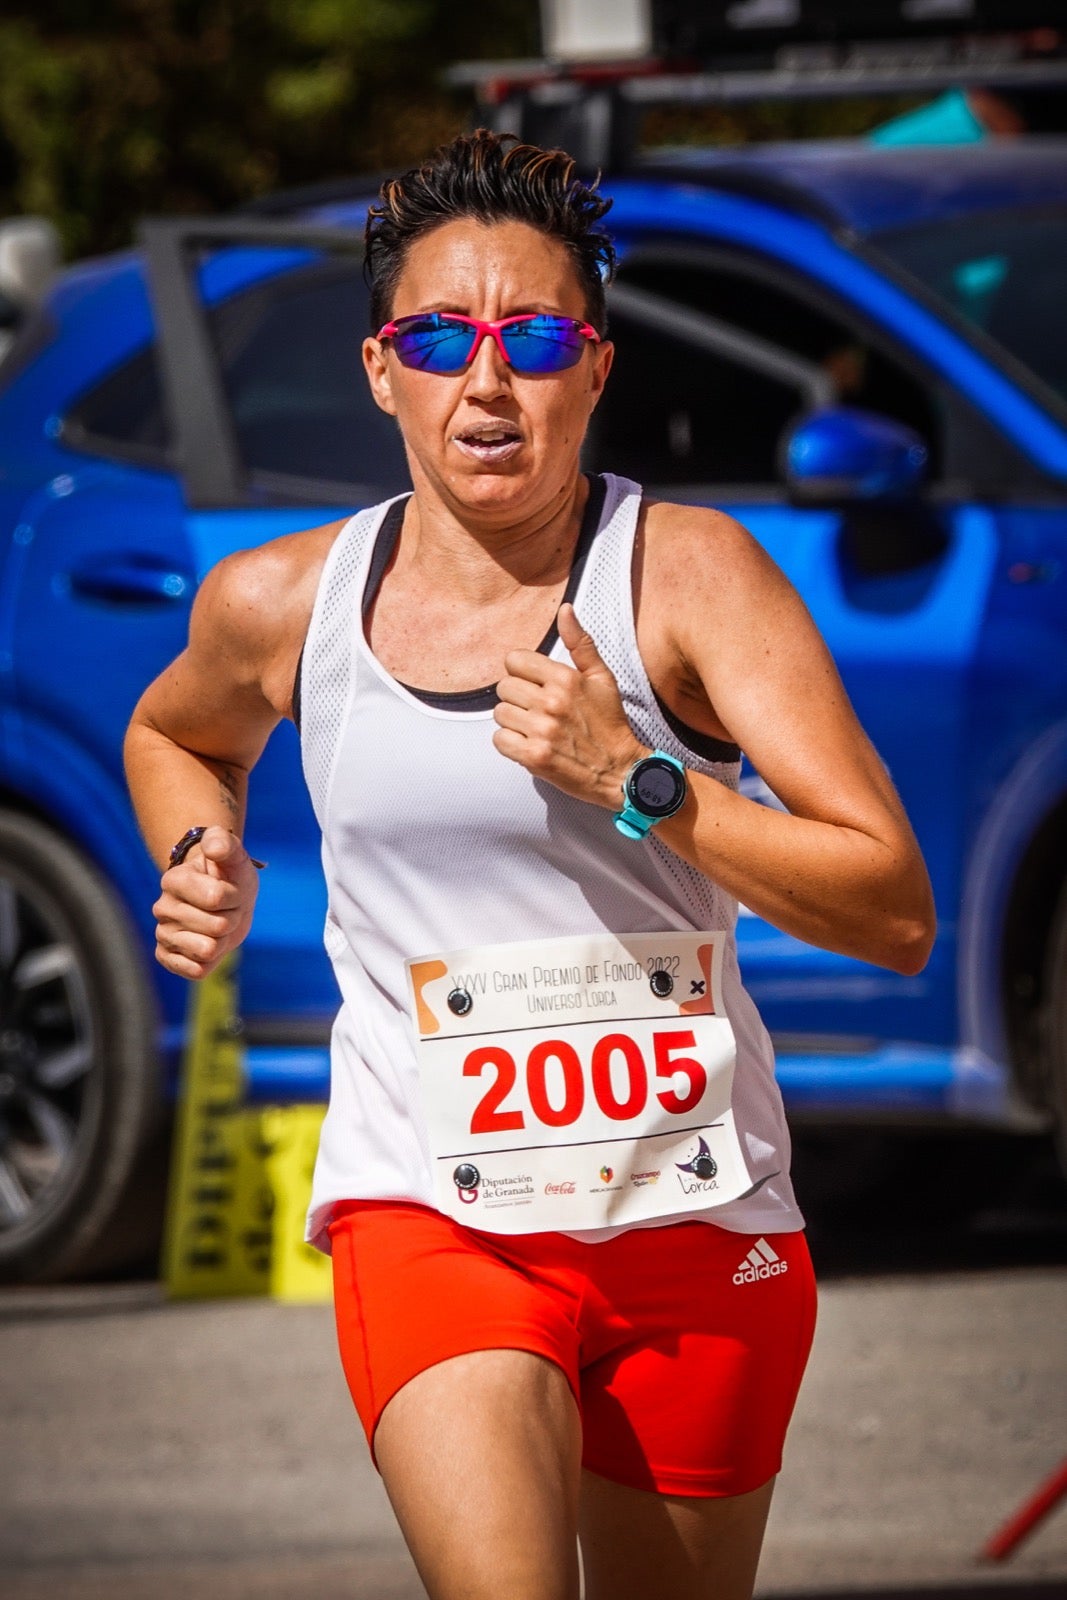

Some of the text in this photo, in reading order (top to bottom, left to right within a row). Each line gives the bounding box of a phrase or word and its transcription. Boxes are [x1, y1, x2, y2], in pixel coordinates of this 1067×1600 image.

[647, 955, 680, 979] 2022
[462, 1030, 707, 1135] 2005
[481, 1174, 533, 1188] Diputación
[482, 1184, 535, 1199] de Granada
[732, 1260, 788, 1286] adidas
